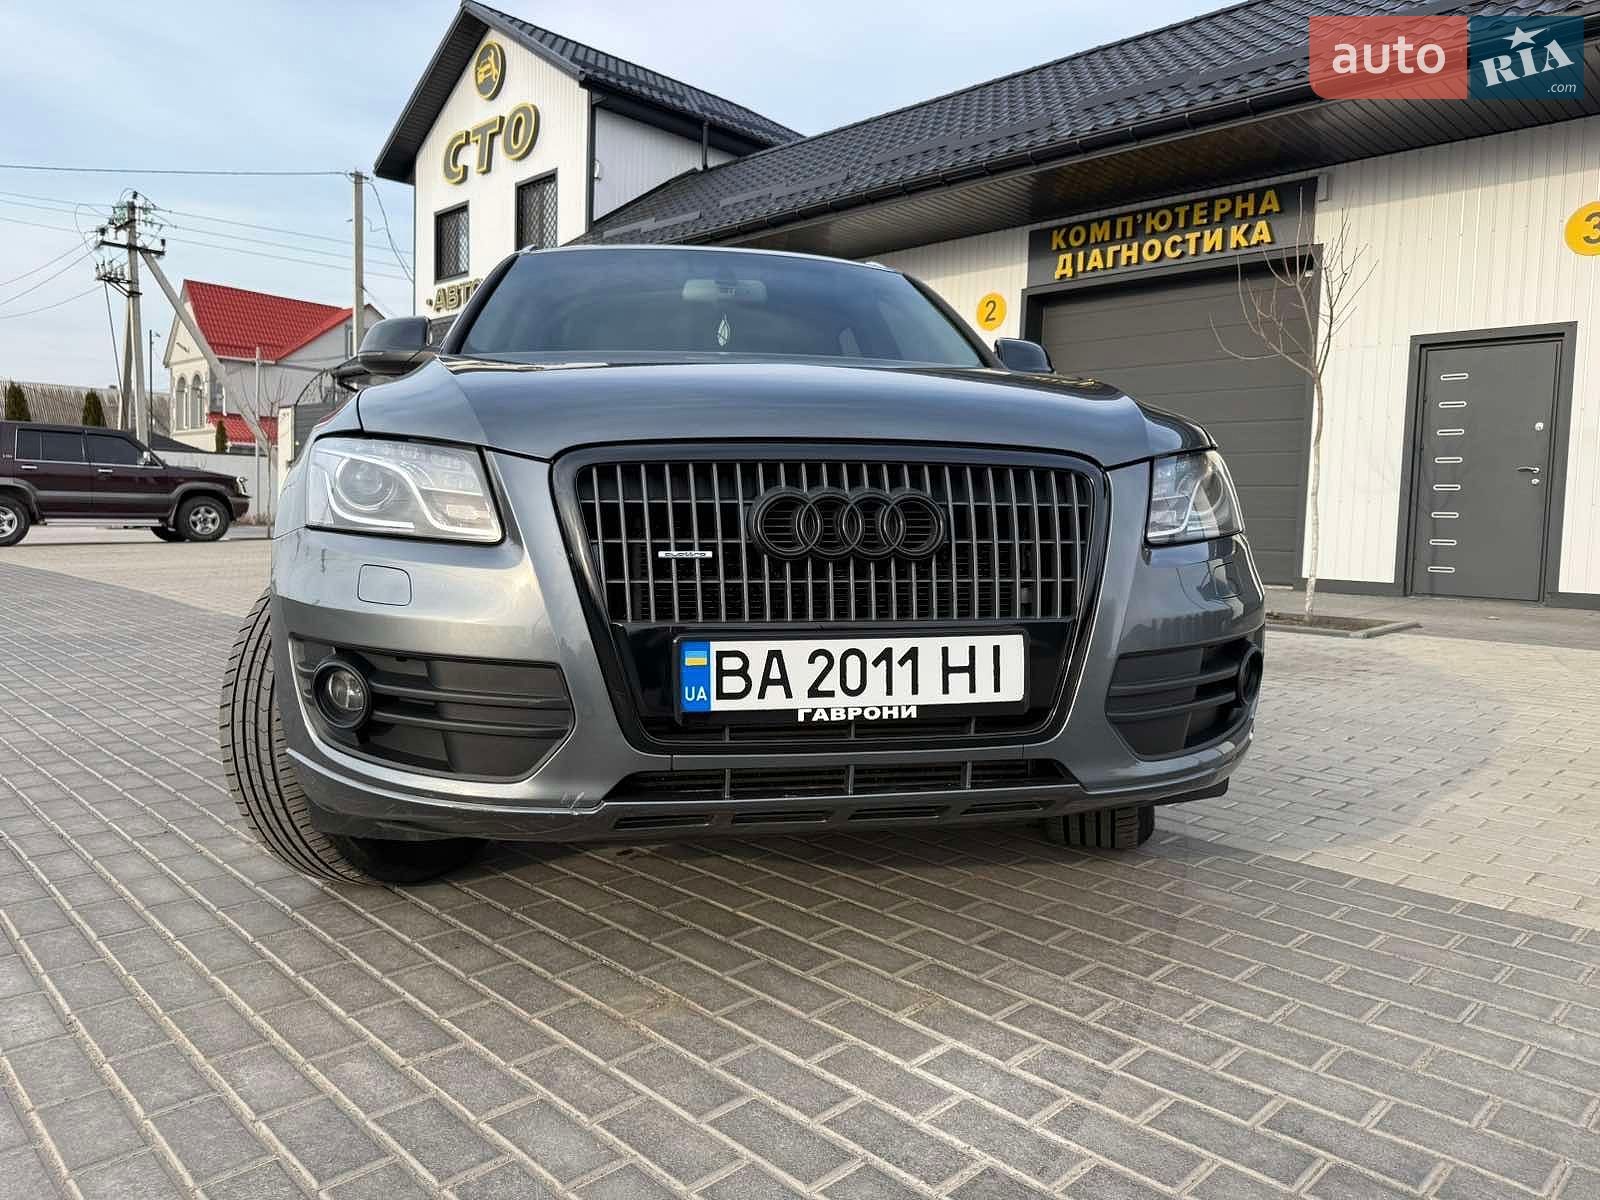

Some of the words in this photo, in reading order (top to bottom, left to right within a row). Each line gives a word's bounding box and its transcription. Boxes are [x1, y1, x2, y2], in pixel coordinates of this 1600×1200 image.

[443, 102, 540, 185] СТО
[1051, 189, 1281, 250] КОМП'ЮТЕРНА
[1583, 211, 1600, 244] 3
[984, 300, 997, 322] 2
[684, 686, 707, 701] UA
[715, 649, 793, 701] BA
[806, 646, 919, 699] 2011
[941, 644, 1002, 696] HI
[797, 705, 918, 722] ГАВРОНИ
